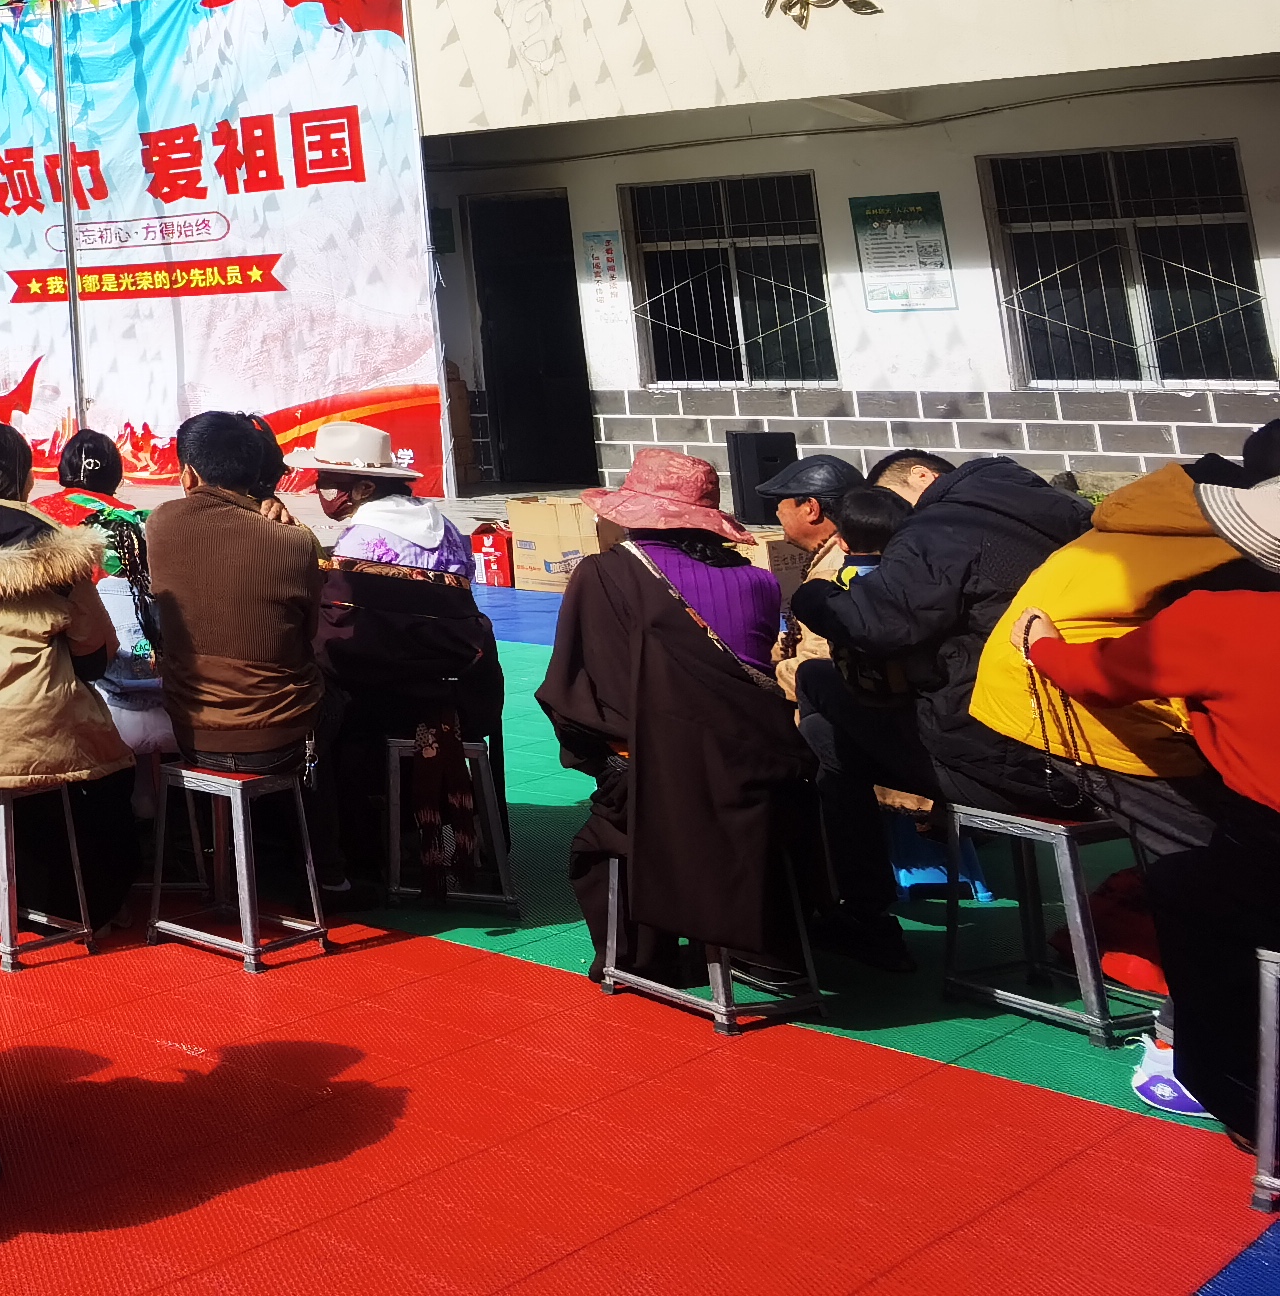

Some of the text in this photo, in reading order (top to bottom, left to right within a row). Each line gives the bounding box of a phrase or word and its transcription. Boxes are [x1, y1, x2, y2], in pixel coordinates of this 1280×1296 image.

[140, 105, 366, 204] 爱祖国
[62, 218, 213, 245] 忘初心·方得始终
